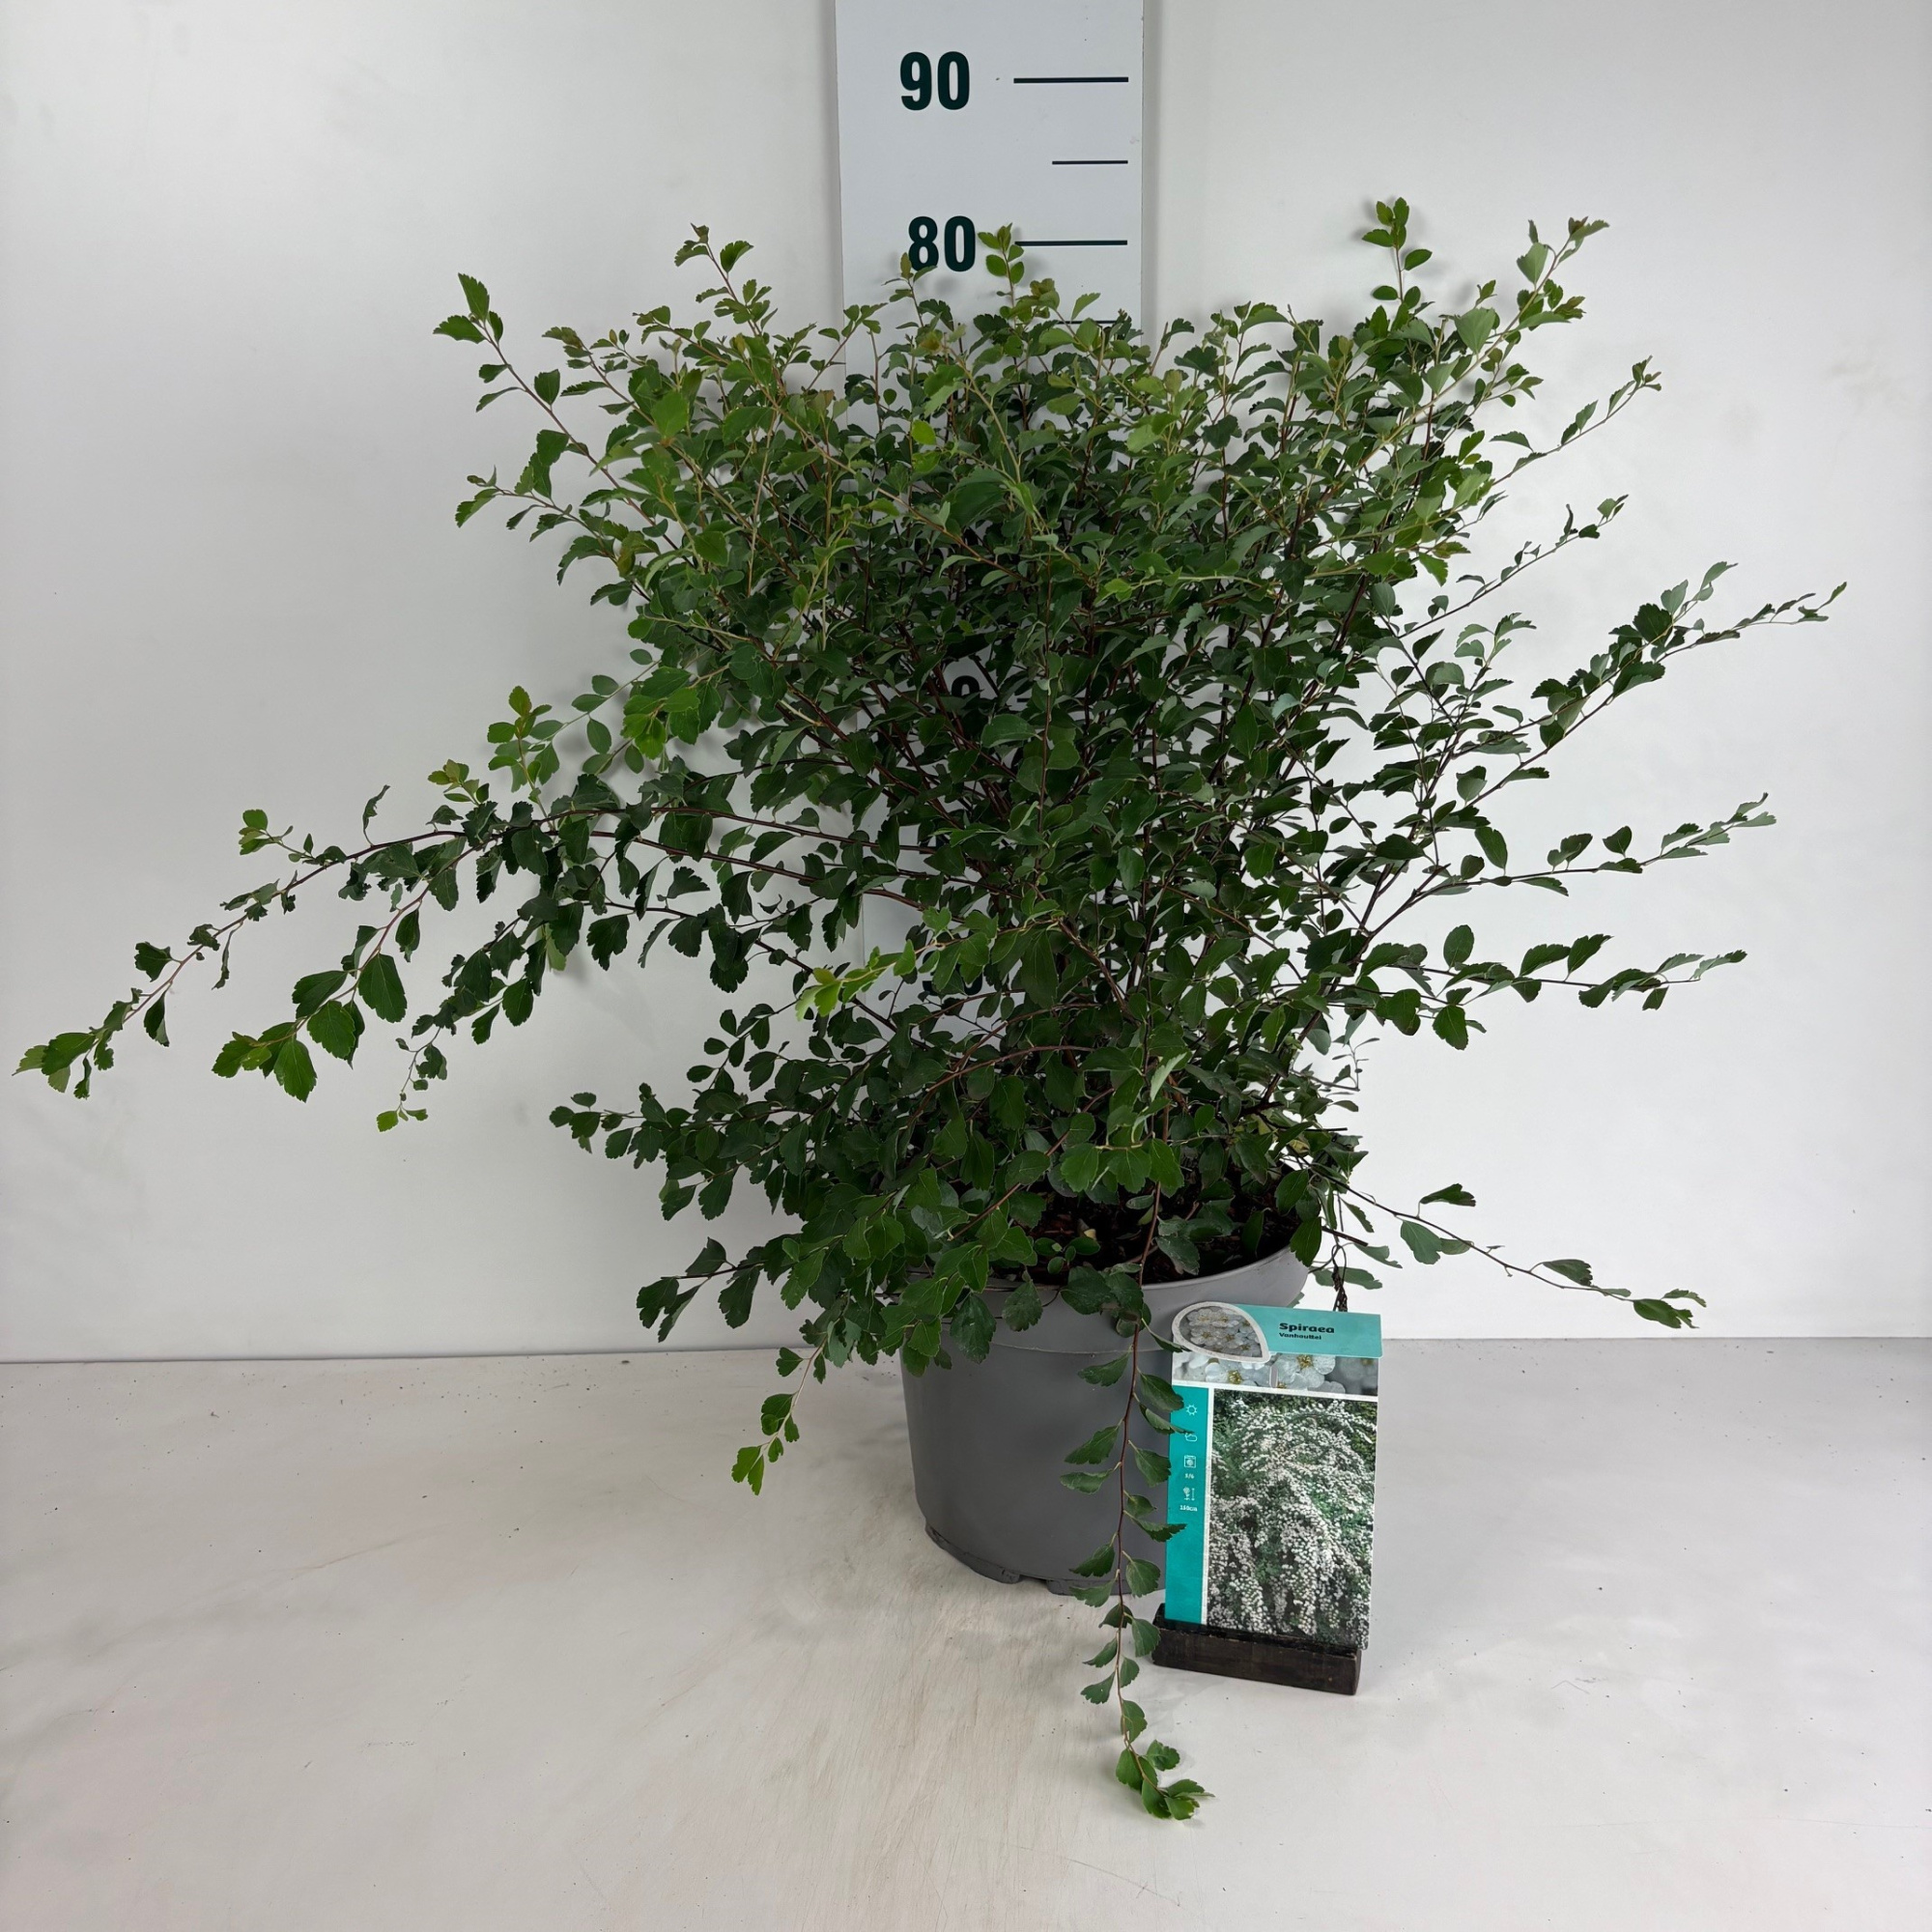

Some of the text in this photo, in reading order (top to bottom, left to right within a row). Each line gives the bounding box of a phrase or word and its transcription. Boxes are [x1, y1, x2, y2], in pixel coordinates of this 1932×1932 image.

[899, 51, 970, 111] 90
[908, 215, 977, 272] 80
[1279, 1322, 1335, 1334] Spiraea
